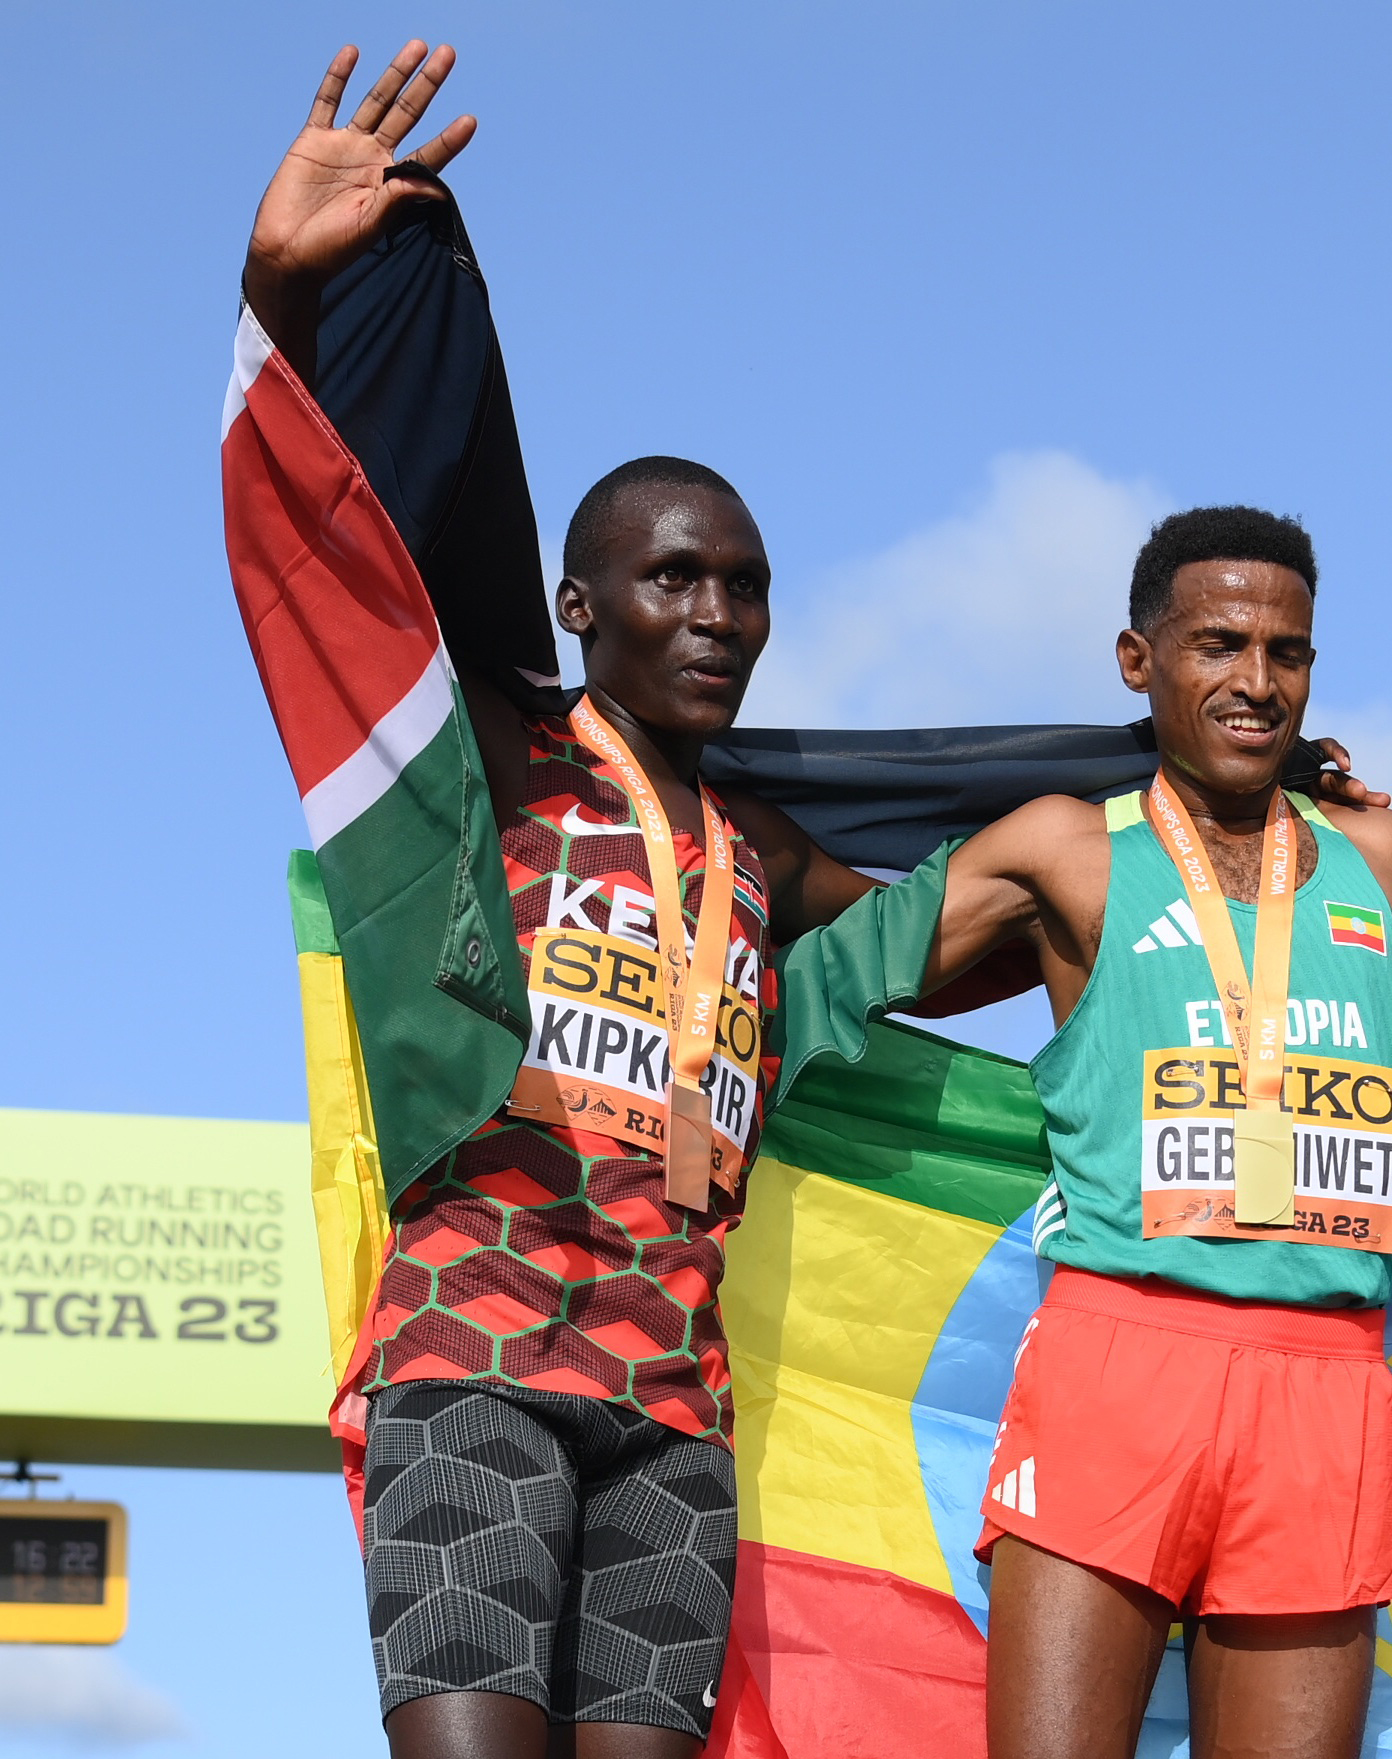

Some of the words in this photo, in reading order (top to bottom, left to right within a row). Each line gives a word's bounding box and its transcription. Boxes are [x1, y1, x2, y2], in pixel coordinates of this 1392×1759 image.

[618, 765, 648, 795] RIGA
[640, 798, 665, 843] 2023
[711, 819, 727, 871] WORLD
[1169, 827, 1193, 857] RIGA
[1183, 856, 1211, 893] 2023
[1270, 847, 1289, 896] WORLD
[546, 873, 759, 1011] KEYA
[543, 937, 757, 1063] SEO
[693, 992, 712, 1023] KM
[691, 1024, 707, 1037] 5
[1185, 999, 1369, 1049] ETOPIA
[1261, 1018, 1277, 1046] KM
[1259, 1049, 1275, 1061] 5
[624, 1107, 665, 1142] RI
[0, 1178, 86, 1208] ORLD
[98, 1182, 285, 1216] ATHLETICS
[0, 1211, 76, 1245] OAD
[90, 1217, 284, 1252] RUNNING
[1291, 1209, 1328, 1235] GA
[1331, 1214, 1370, 1239] 23
[0, 1251, 283, 1289] AMPIONSHIPS
[0, 1290, 158, 1340] IGA
[177, 1296, 280, 1344] 23
